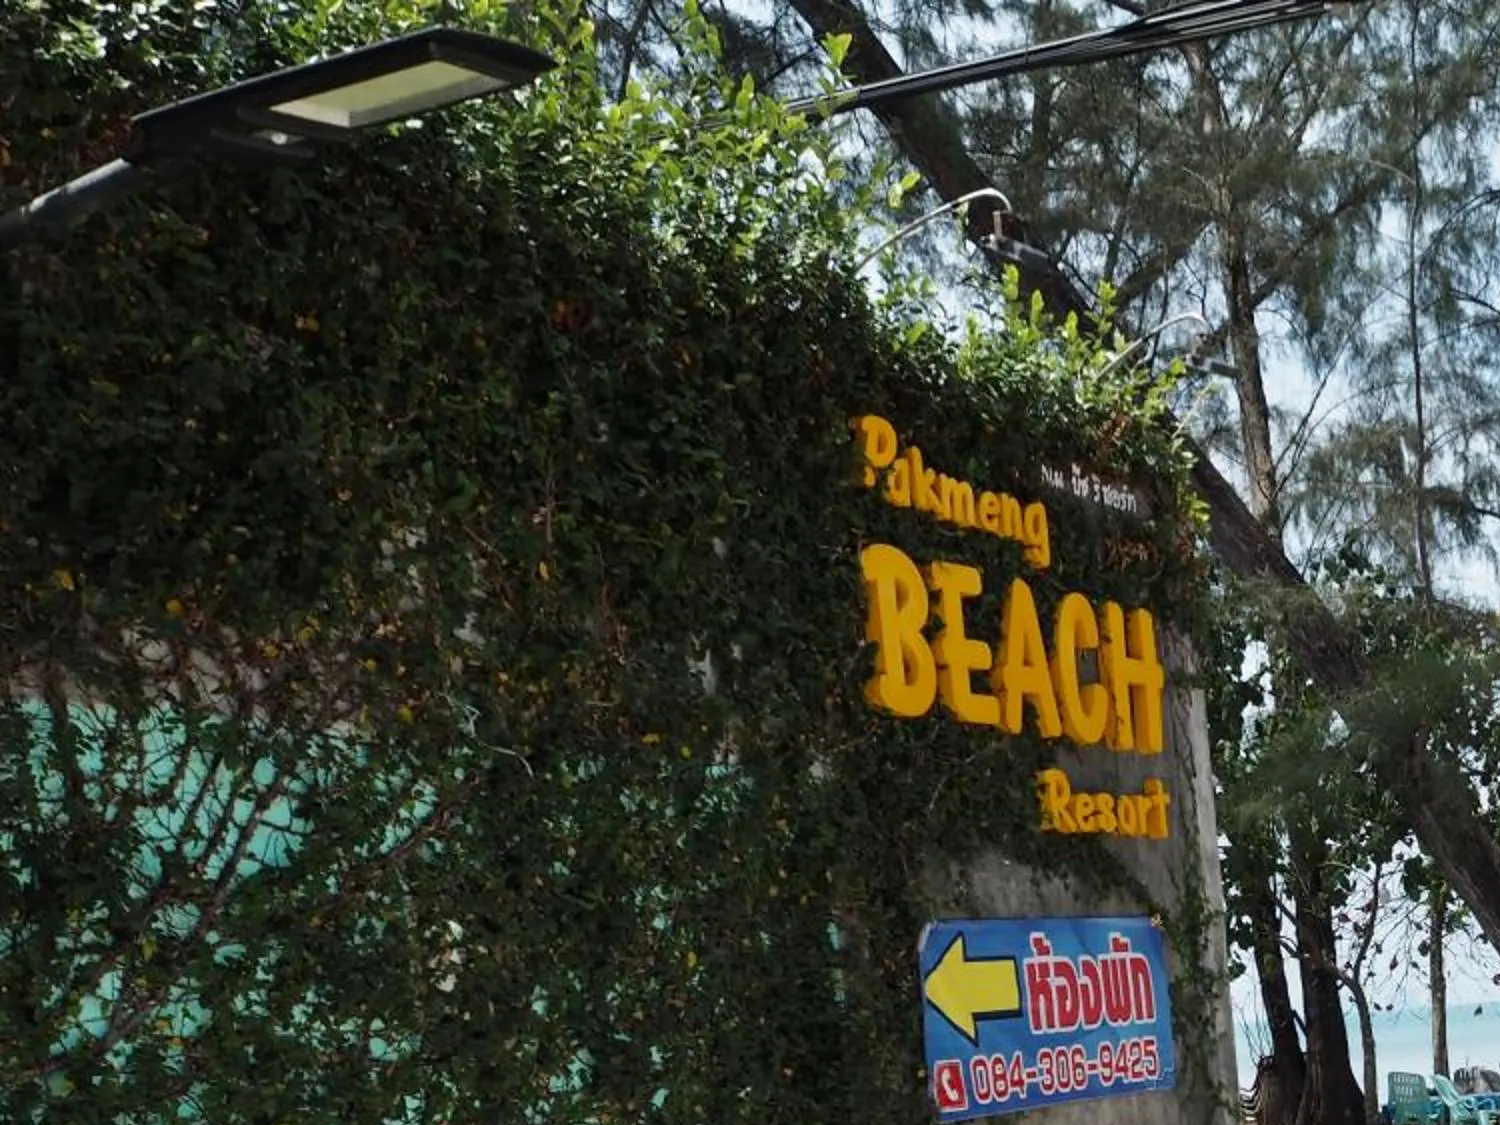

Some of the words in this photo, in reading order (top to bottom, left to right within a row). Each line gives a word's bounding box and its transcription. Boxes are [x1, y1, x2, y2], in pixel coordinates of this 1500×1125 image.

[855, 414, 1051, 569] Pakmeng
[860, 542, 1165, 755] BEACH
[1038, 767, 1171, 839] Resort
[1023, 931, 1156, 1034] ห้องพัก
[970, 1036, 1160, 1104] 084-306-9425
